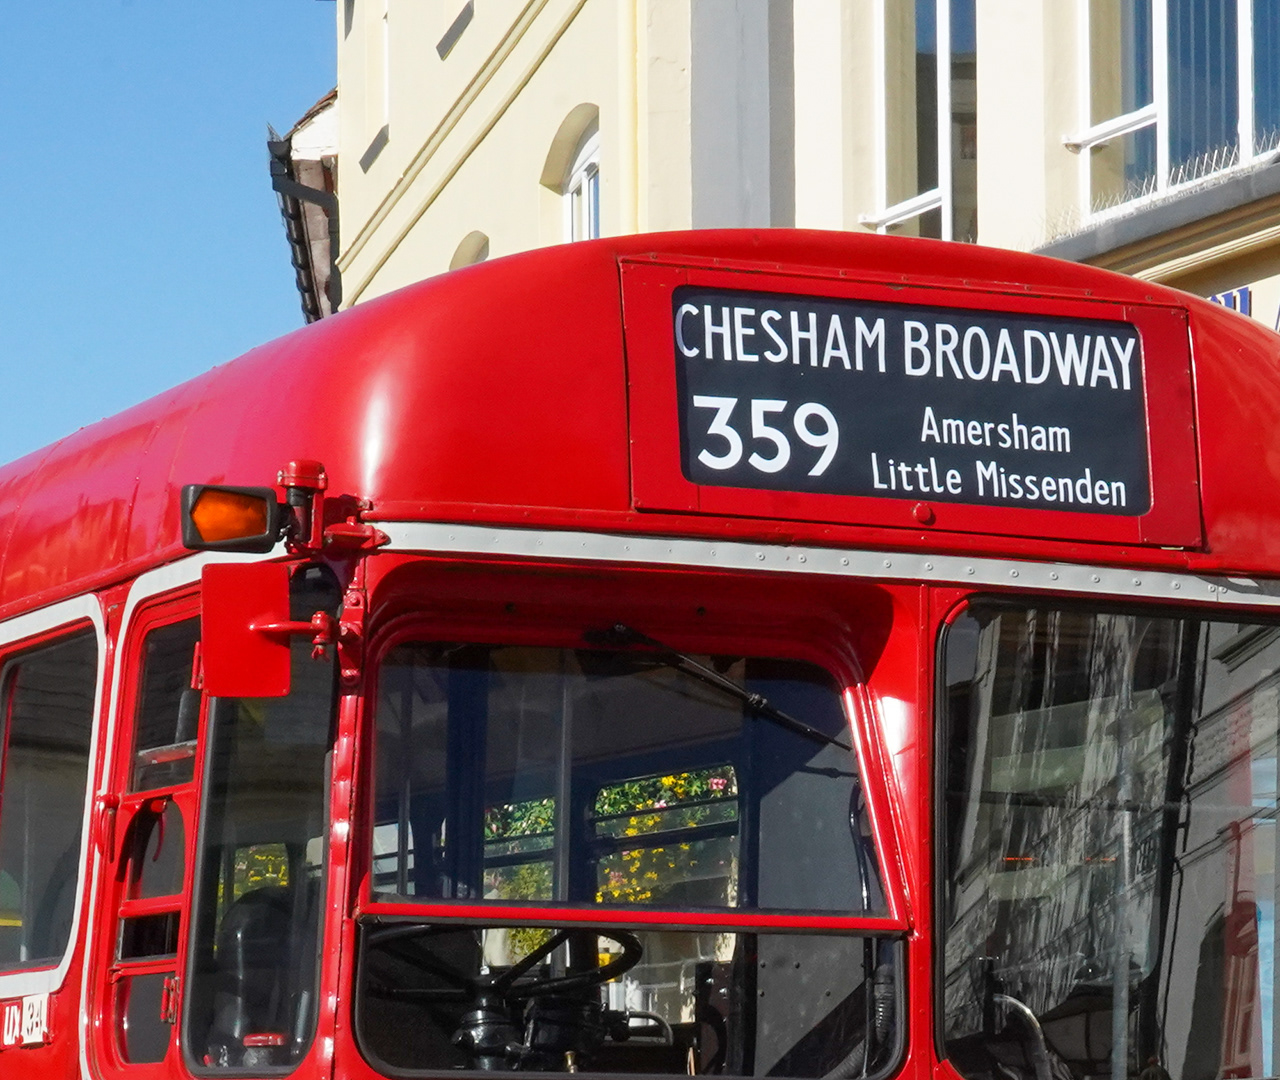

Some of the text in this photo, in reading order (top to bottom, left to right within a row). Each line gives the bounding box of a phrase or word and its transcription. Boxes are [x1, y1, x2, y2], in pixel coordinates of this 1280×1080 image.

[675, 303, 1136, 390] CHESHAM BROADWAY
[692, 395, 840, 476] 359
[920, 406, 1071, 453] Amersham
[871, 452, 1127, 507] Little Missenden
